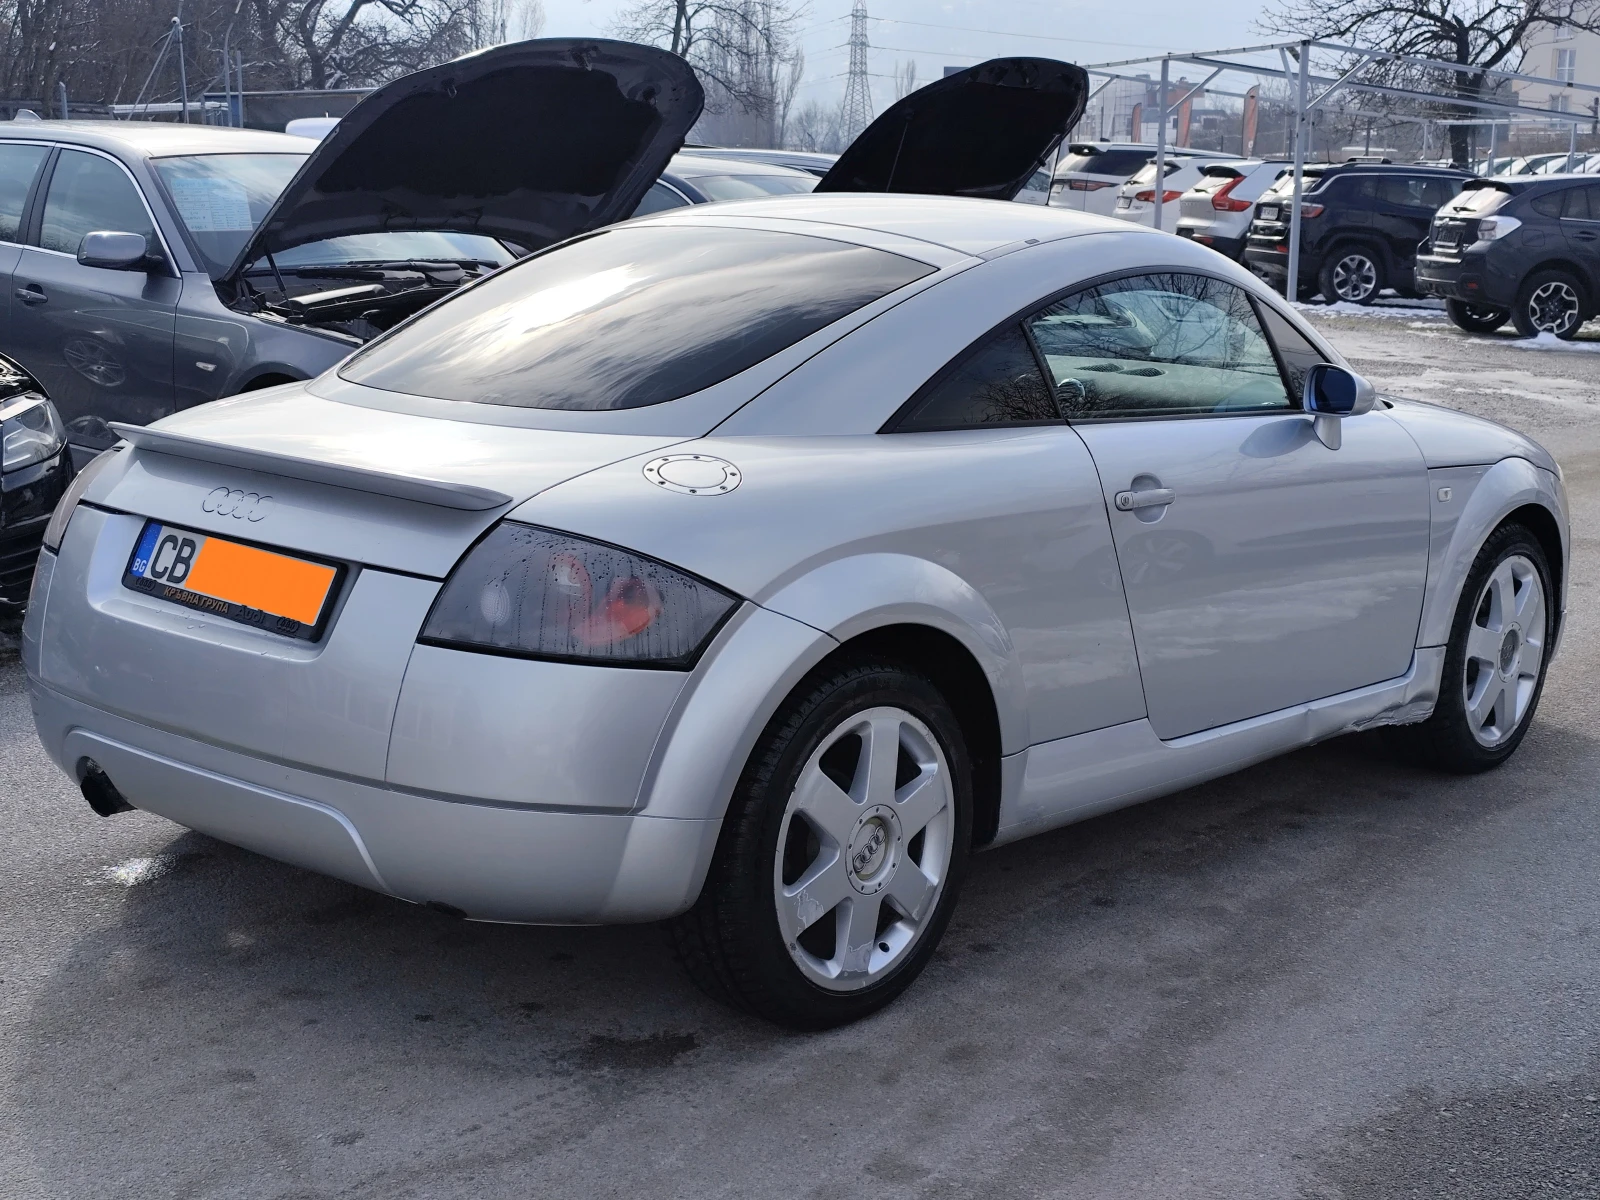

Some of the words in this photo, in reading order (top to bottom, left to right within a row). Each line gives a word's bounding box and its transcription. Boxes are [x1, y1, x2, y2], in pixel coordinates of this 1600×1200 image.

[133, 558, 147, 573] BG
[151, 534, 196, 584] CB
[163, 586, 199, 605] КРЪВНА
[200, 598, 229, 614] ГРУПА
